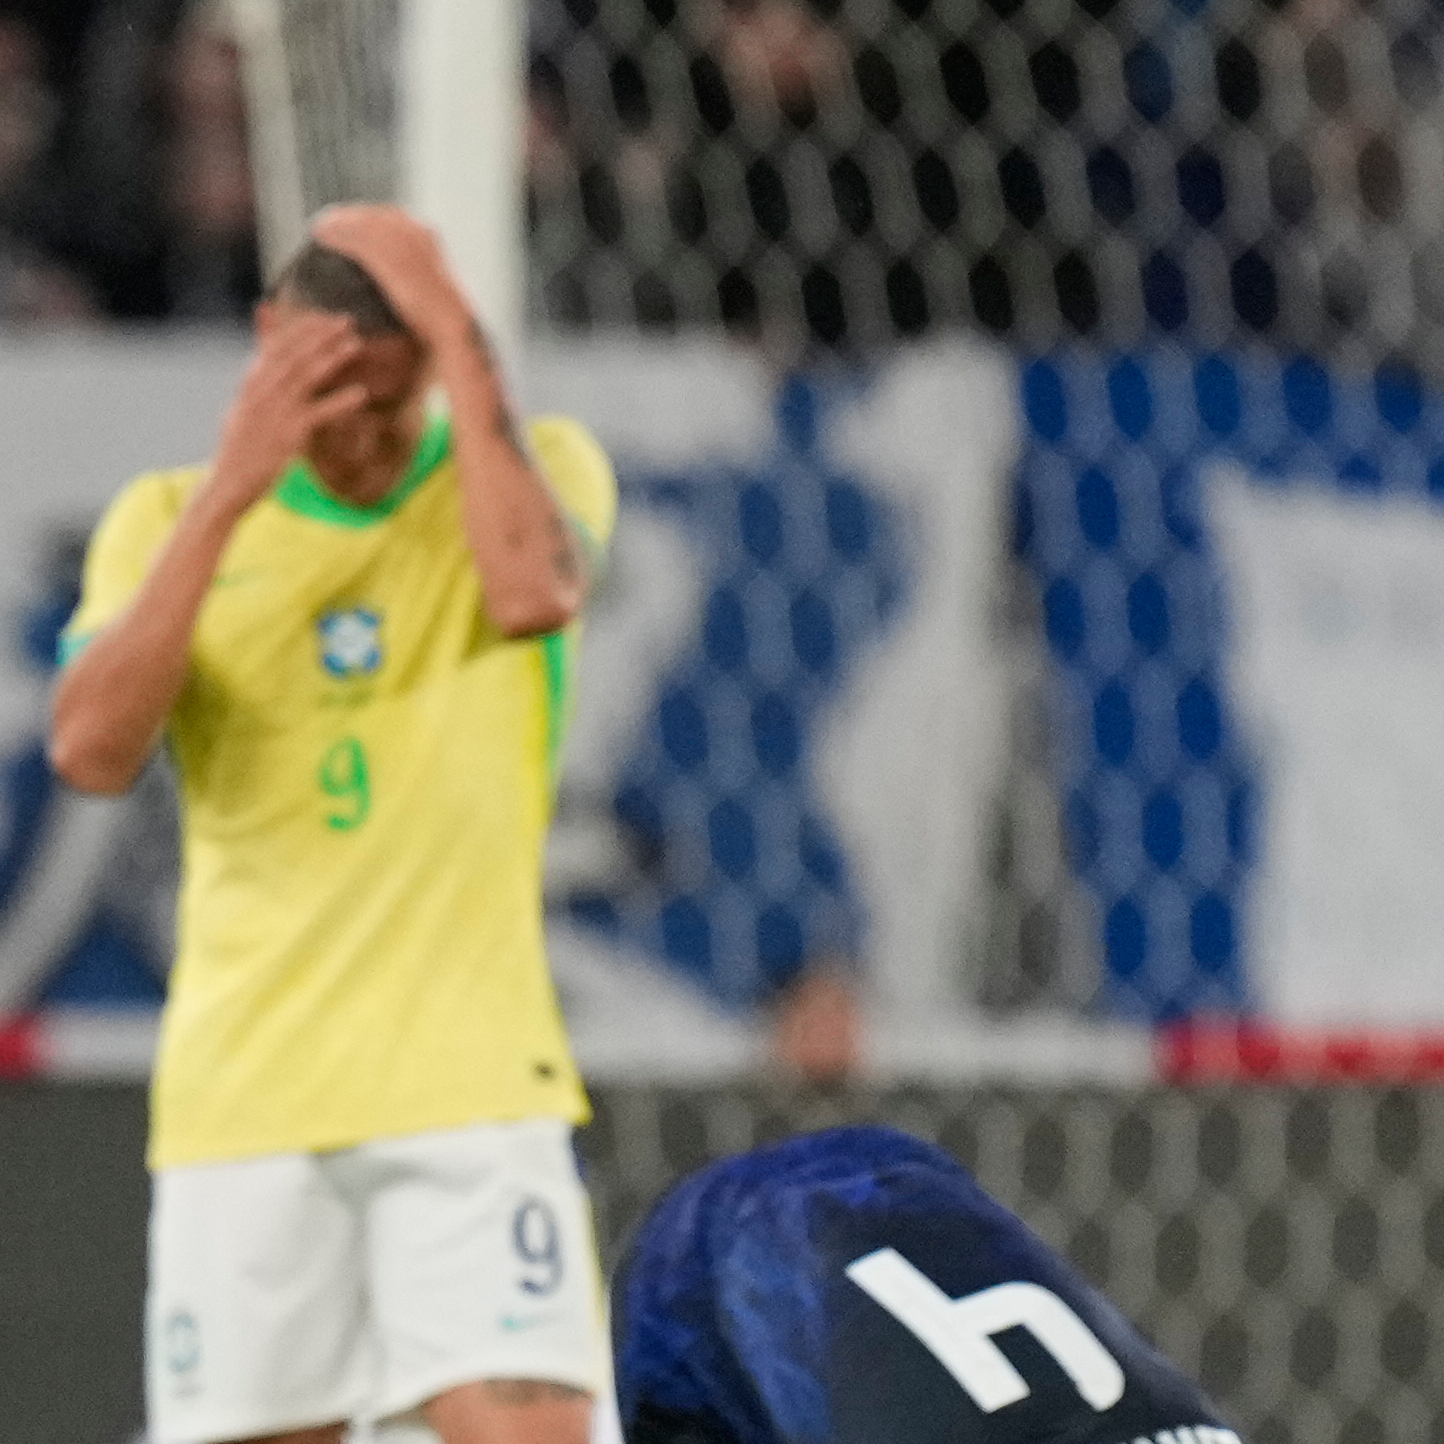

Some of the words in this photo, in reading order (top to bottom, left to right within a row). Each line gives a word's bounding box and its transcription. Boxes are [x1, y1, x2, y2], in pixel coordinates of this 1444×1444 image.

[320, 738, 370, 831] 9
[513, 1200, 564, 1296] 9
[844, 1246, 1125, 1414] 4
